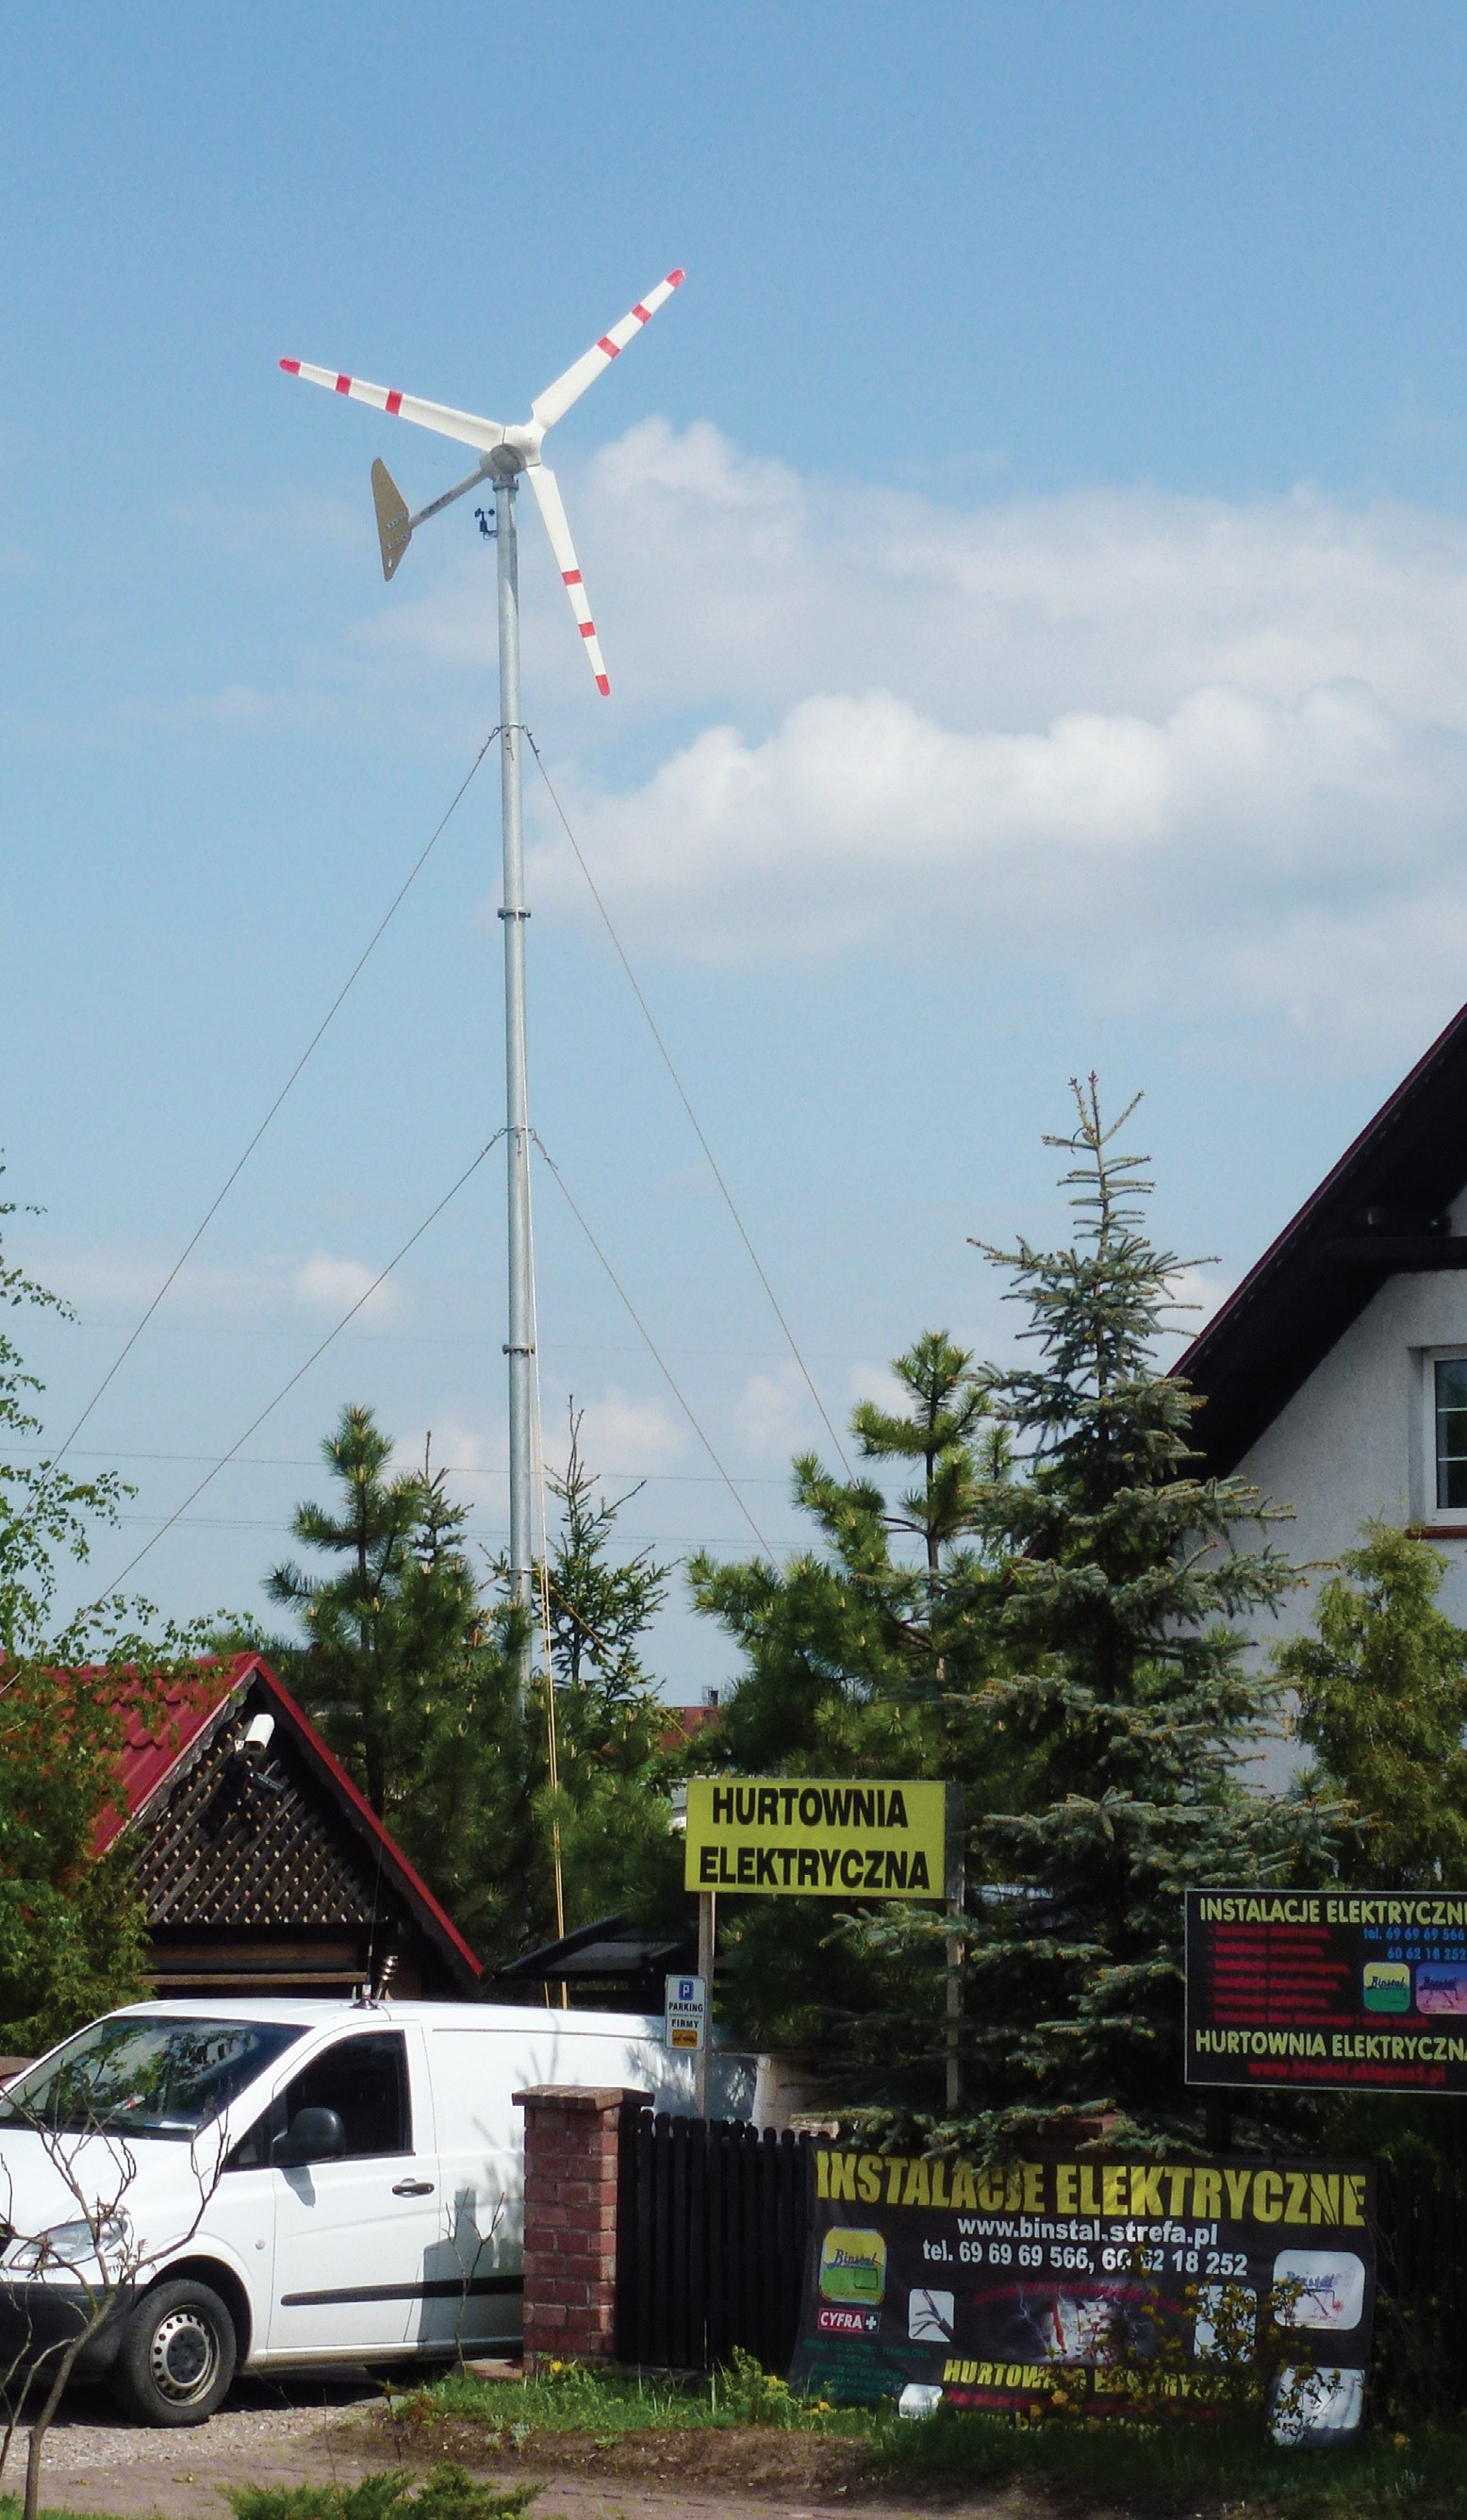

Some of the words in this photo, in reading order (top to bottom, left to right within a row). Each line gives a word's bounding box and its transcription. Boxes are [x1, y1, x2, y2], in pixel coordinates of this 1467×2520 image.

[713, 1787, 908, 1828] HURTOWNIA
[700, 1846, 930, 1890] ELEKTRYCZNA
[1200, 1898, 1320, 1923] INSTALACJE
[1363, 1928, 1382, 1940] tel.
[1386, 1928, 1401, 1940] 69
[1405, 1928, 1420, 1940] 69
[1424, 1928, 1439, 1941] 69
[1442, 1928, 1465, 1941] 566
[1387, 1947, 1403, 1960] 60
[1406, 1948, 1421, 1960] 62
[1426, 1948, 1441, 1960] 18
[1443, 1948, 1467, 1961] 252
[683, 1984, 690, 1997] P
[668, 2002, 703, 2013] PARKING
[671, 2019, 700, 2028] FIRMY
[1195, 2030, 1327, 2057] HURTOWNIA
[816, 2150, 1046, 2213] INSTALACJE
[1057, 2165, 1365, 2227] ELEKTRYCZNE
[958, 2216, 1218, 2249] www.binstal.strefa.pl
[923, 2239, 952, 2262] tel.
[960, 2242, 982, 2263] 69
[989, 2243, 1013, 2264] 69
[1019, 2245, 1043, 2266] 69
[1050, 2246, 1094, 2274] 566,
[1172, 2250, 1198, 2273] 18
[1206, 2252, 1247, 2276] 252
